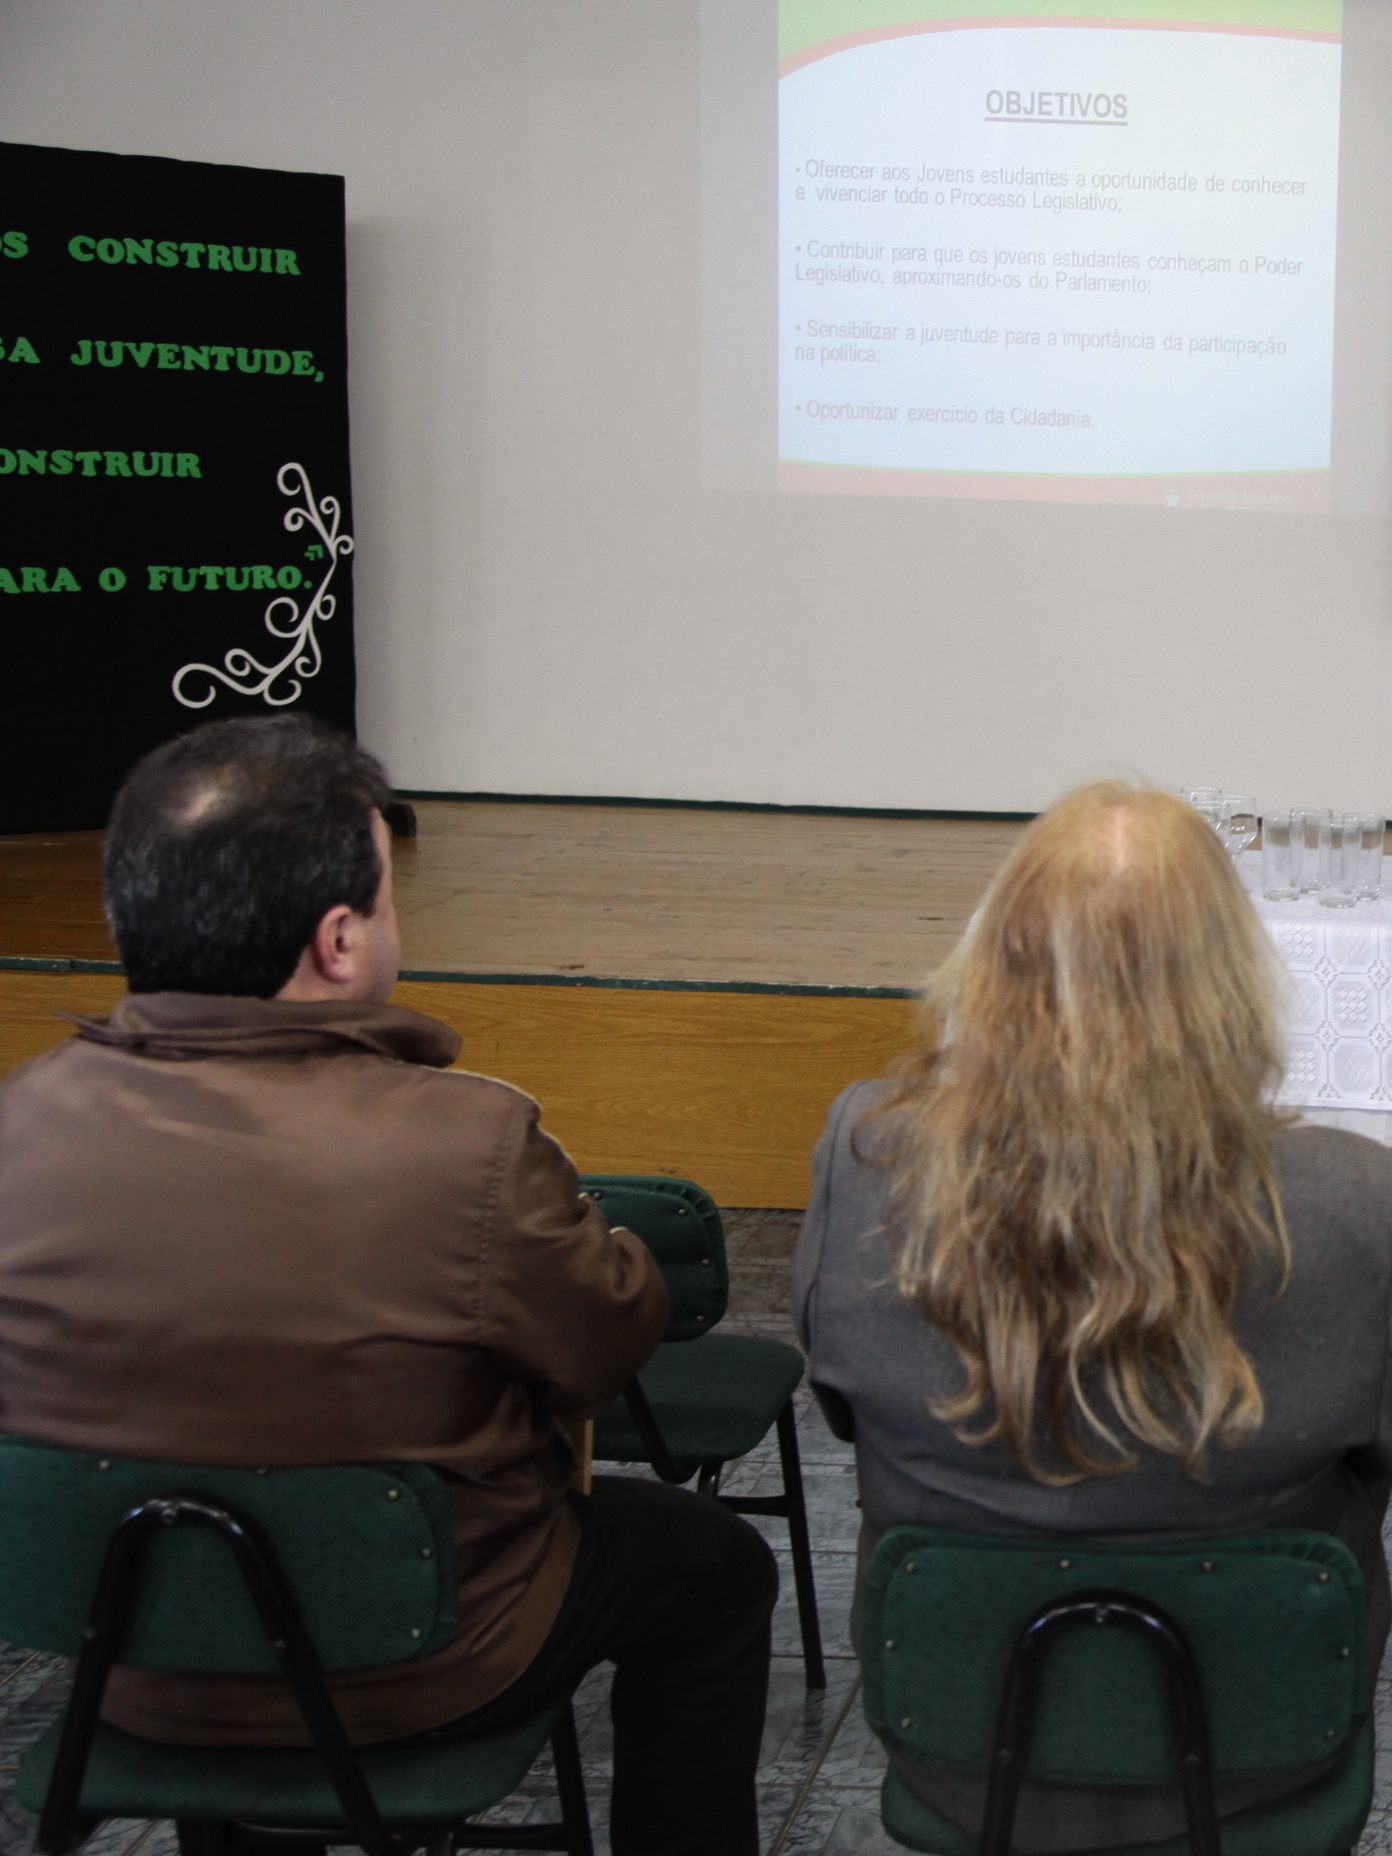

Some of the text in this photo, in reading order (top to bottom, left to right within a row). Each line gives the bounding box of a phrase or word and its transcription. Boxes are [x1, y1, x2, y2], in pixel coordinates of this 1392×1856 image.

[986, 89, 1128, 120] OBJETIVOS
[805, 159, 1308, 195] Oferecer aos Jovens estudantes a oportunidade de conhecer
[795, 185, 1122, 214] e vivenciar todo o Processo Legislativo;
[0, 231, 300, 275] S CONSTRUIR
[806, 239, 1303, 276] Contribuir para que os jovens estudantes conheçam o Poder
[795, 262, 1152, 295] Legislativo, aproximando-os do Parlamento;
[795, 344, 881, 366] na política;
[806, 319, 1287, 358] Sensibilizar a juventude para a importância da participação
[0, 337, 324, 383] A JUVENTUDE,
[806, 400, 1094, 428] Oportunizar exercício da Cidadania.
[98, 567, 127, 592] O
